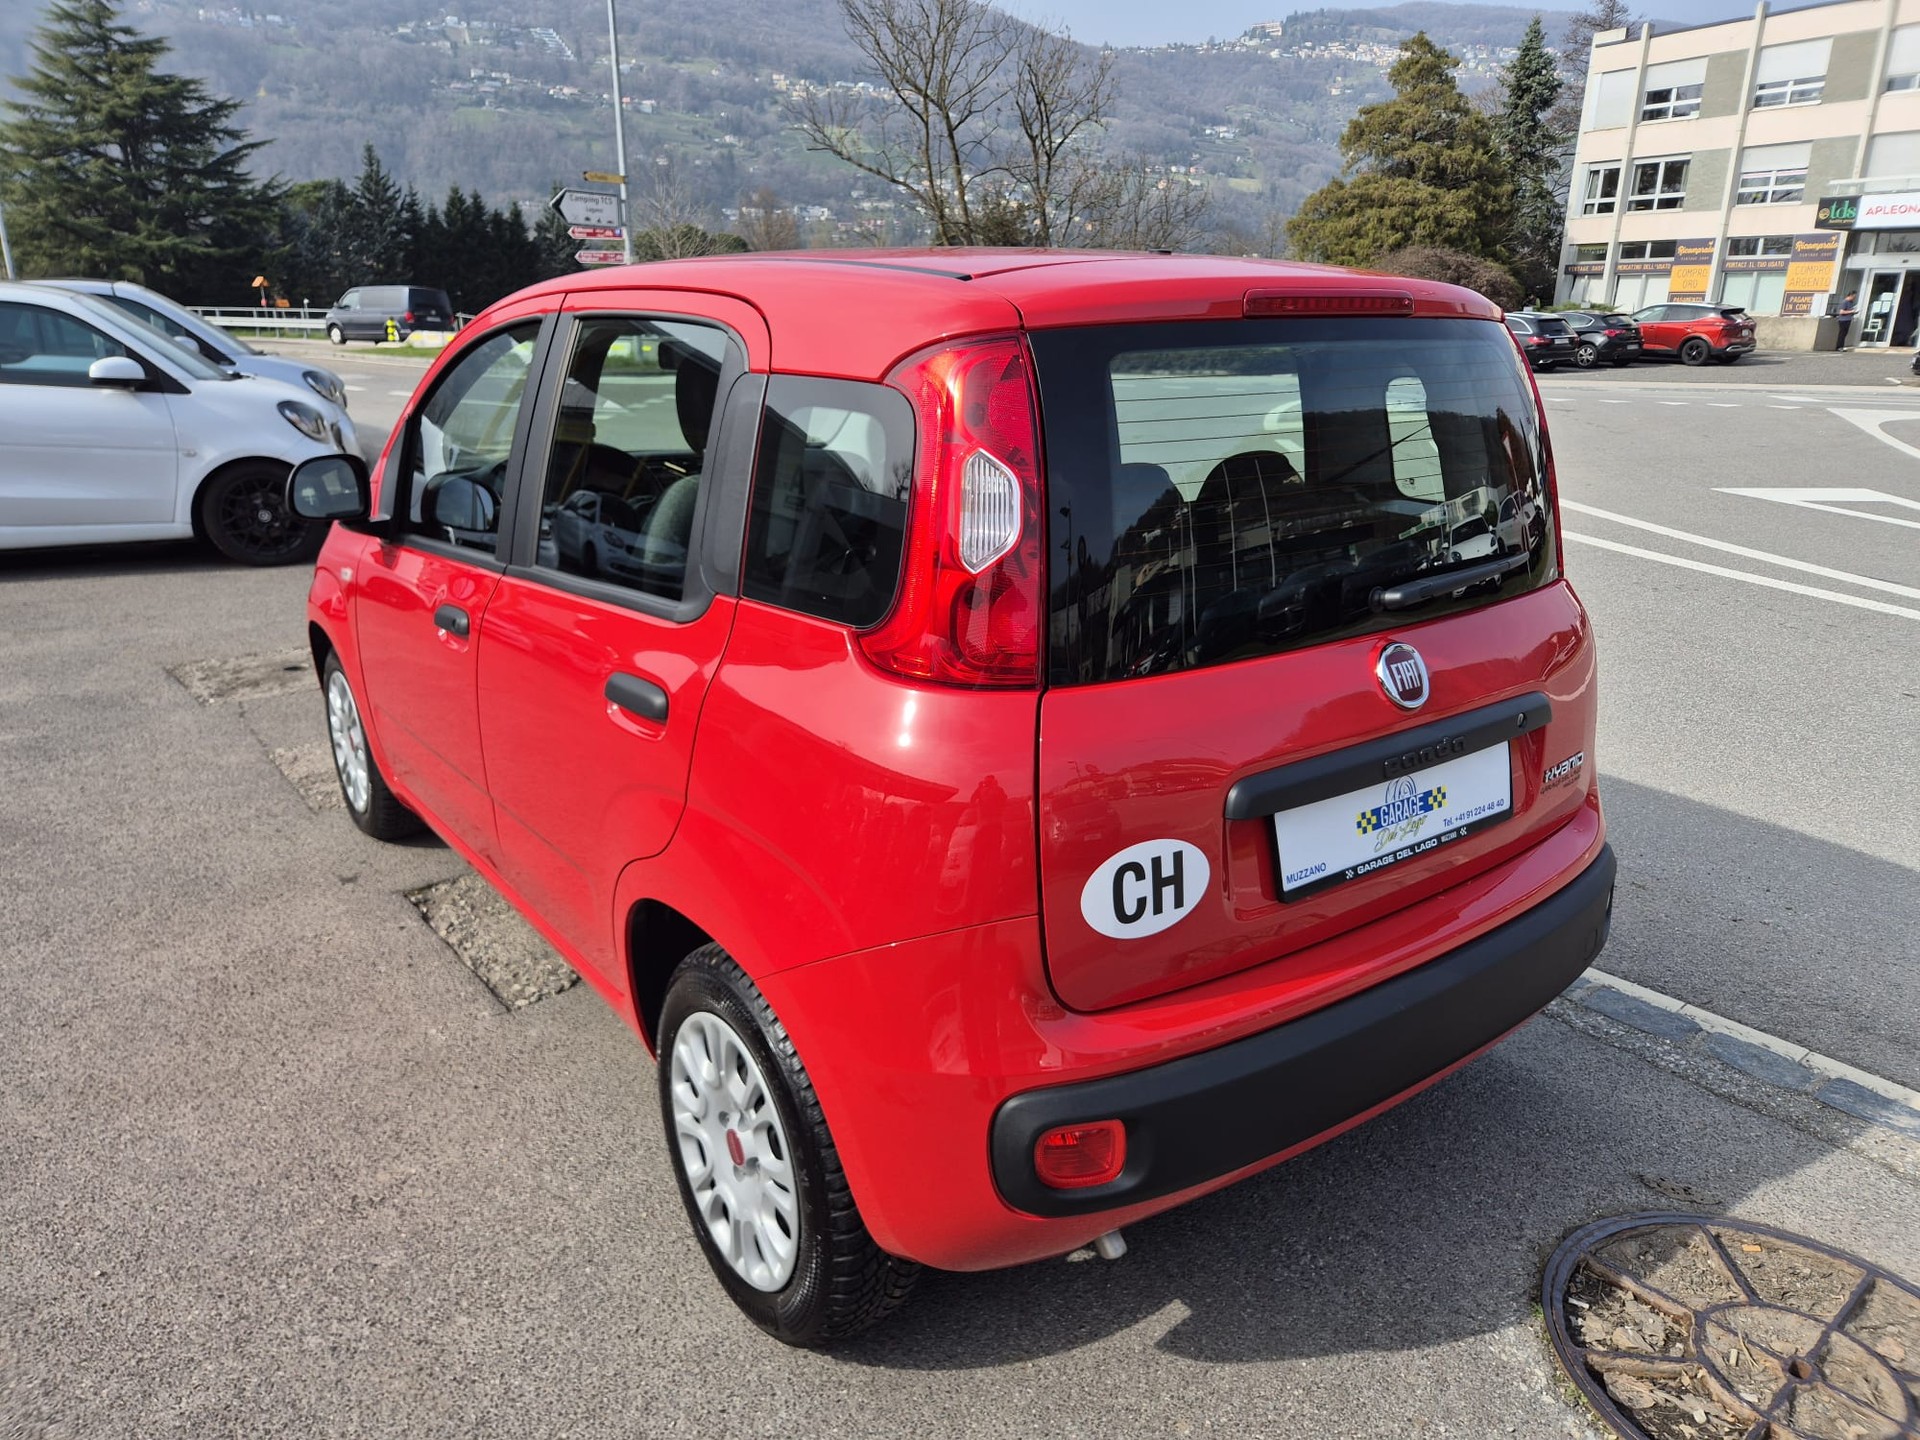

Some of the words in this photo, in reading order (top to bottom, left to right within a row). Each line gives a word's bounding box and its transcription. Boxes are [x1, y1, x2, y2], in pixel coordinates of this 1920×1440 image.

[569, 194, 599, 205] Camping
[1829, 199, 1857, 219] tds
[1676, 267, 1708, 278] COMPRO
[1682, 279, 1698, 289] ORO
[1795, 265, 1831, 275] COMPRO
[1390, 659, 1421, 692] FIAT
[1543, 751, 1584, 783] HYBRID
[1380, 794, 1425, 826] GARAGE
[1443, 818, 1453, 827] Tel.
[1455, 812, 1466, 822] +41
[1466, 810, 1474, 819] 91
[1474, 804, 1486, 816] 224
[1486, 801, 1495, 810] 48
[1496, 798, 1505, 807] 40
[1374, 823, 1398, 853] Del
[1399, 815, 1428, 841] Lago
[1357, 854, 1395, 874] GARAGE
[1396, 848, 1414, 858] DEL
[1415, 838, 1438, 852] LAGO
[1112, 850, 1184, 924] CH
[1286, 862, 1327, 885] MUZZANO
